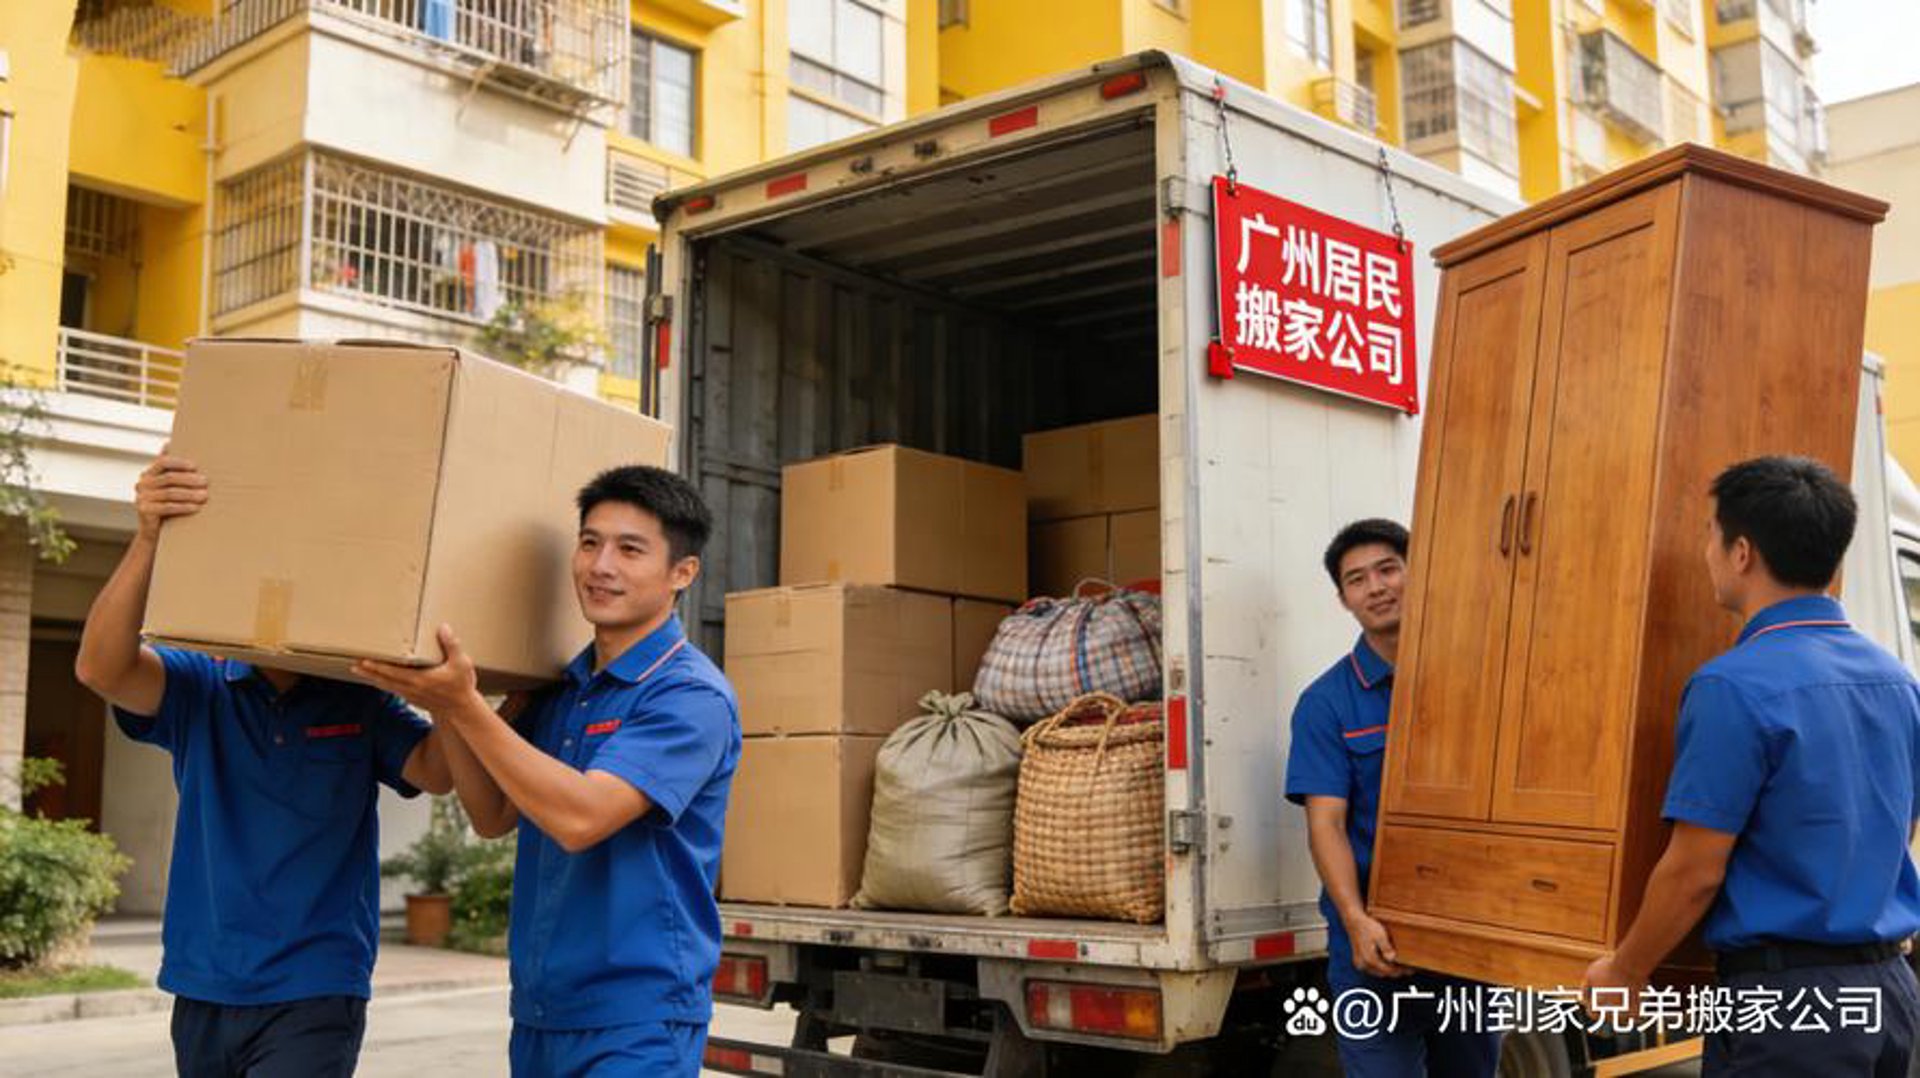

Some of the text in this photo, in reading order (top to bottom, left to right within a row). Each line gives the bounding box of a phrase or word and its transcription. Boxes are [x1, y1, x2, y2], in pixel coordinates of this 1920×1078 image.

[1236, 212, 1402, 319] 广州居民
[1234, 280, 1403, 385] 搬家公司
